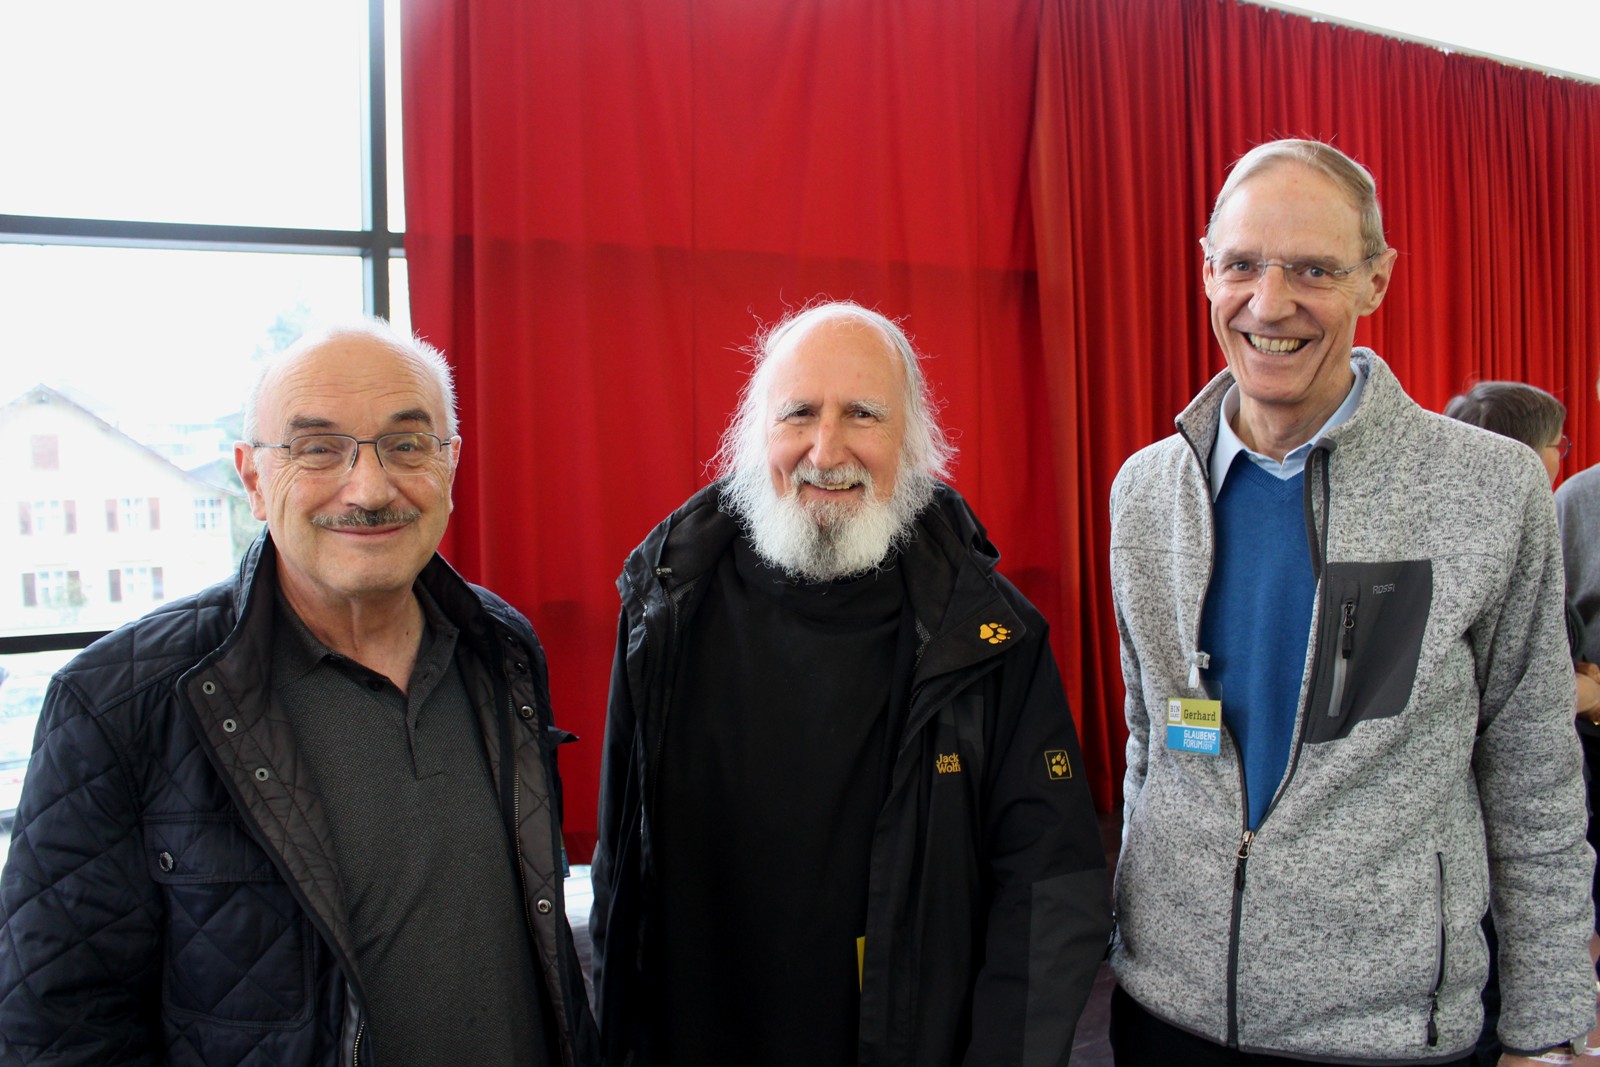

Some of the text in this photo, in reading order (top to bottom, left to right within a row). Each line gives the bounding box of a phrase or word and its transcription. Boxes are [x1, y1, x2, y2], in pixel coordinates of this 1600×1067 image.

[1372, 583, 1396, 595] ROSSI
[1183, 709, 1216, 721] Gerhard
[1183, 729, 1217, 741] GLAUBENS
[936, 752, 959, 764] Jack
